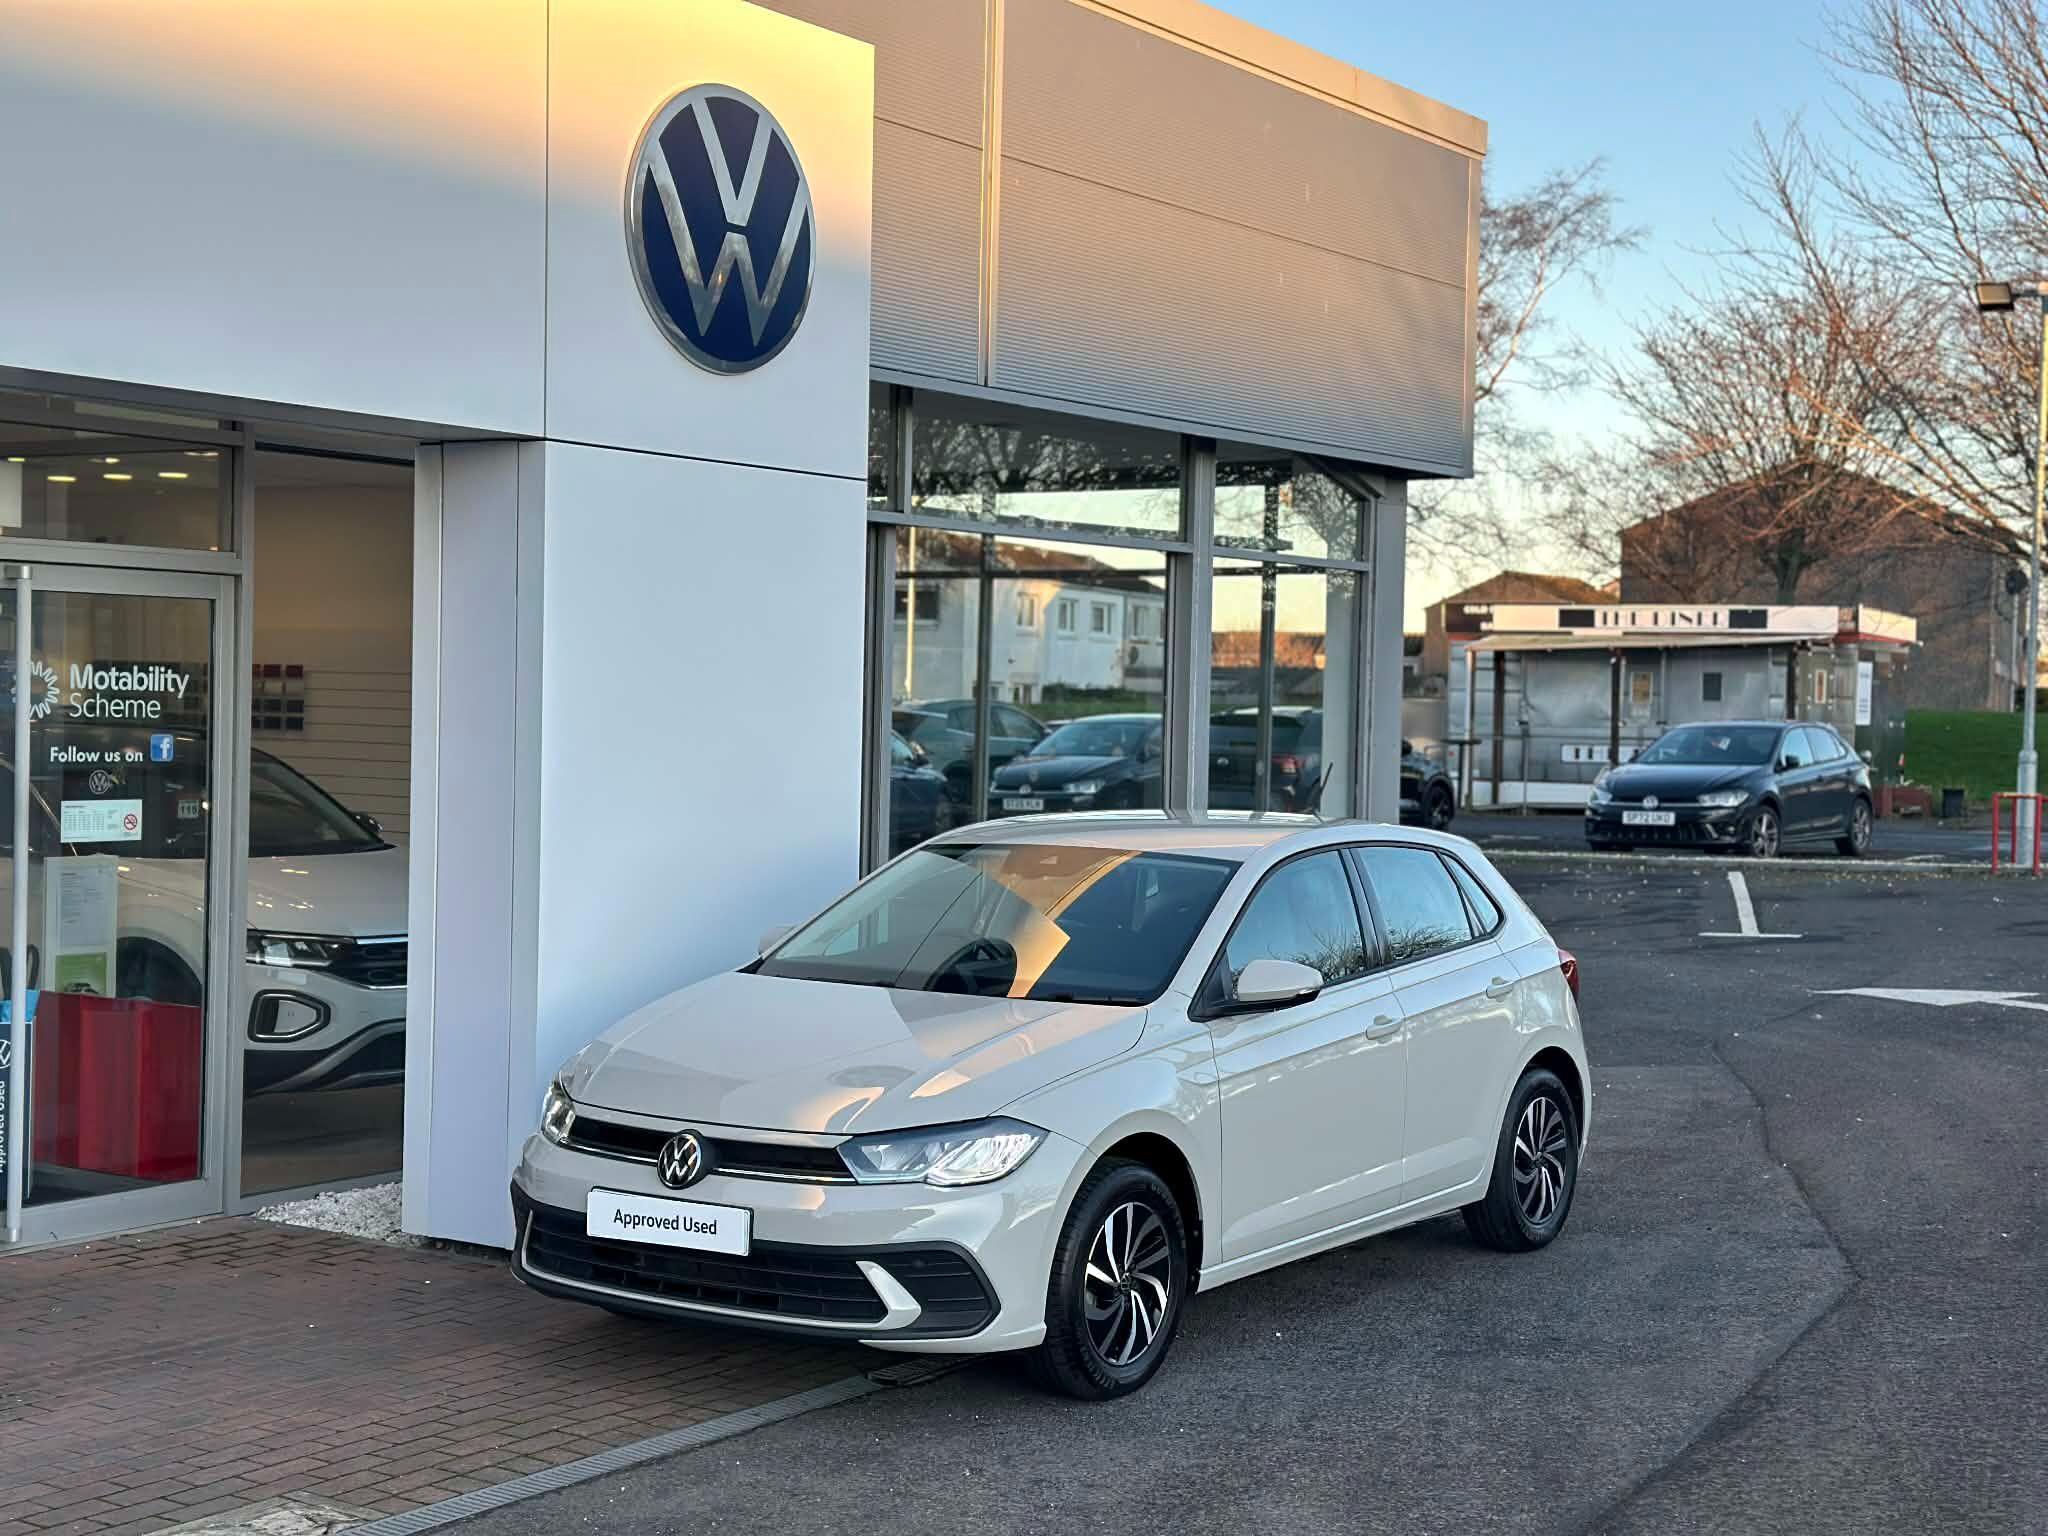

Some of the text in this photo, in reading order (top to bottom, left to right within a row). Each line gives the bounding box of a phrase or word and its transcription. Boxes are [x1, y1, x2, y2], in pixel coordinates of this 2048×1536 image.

[633, 92, 811, 350] VW
[70, 663, 189, 699] Motability
[69, 692, 161, 718] Scheme
[50, 745, 100, 762] Follow
[104, 751, 121, 762] us
[125, 751, 144, 762] on
[614, 1209, 717, 1235] Approved Used
